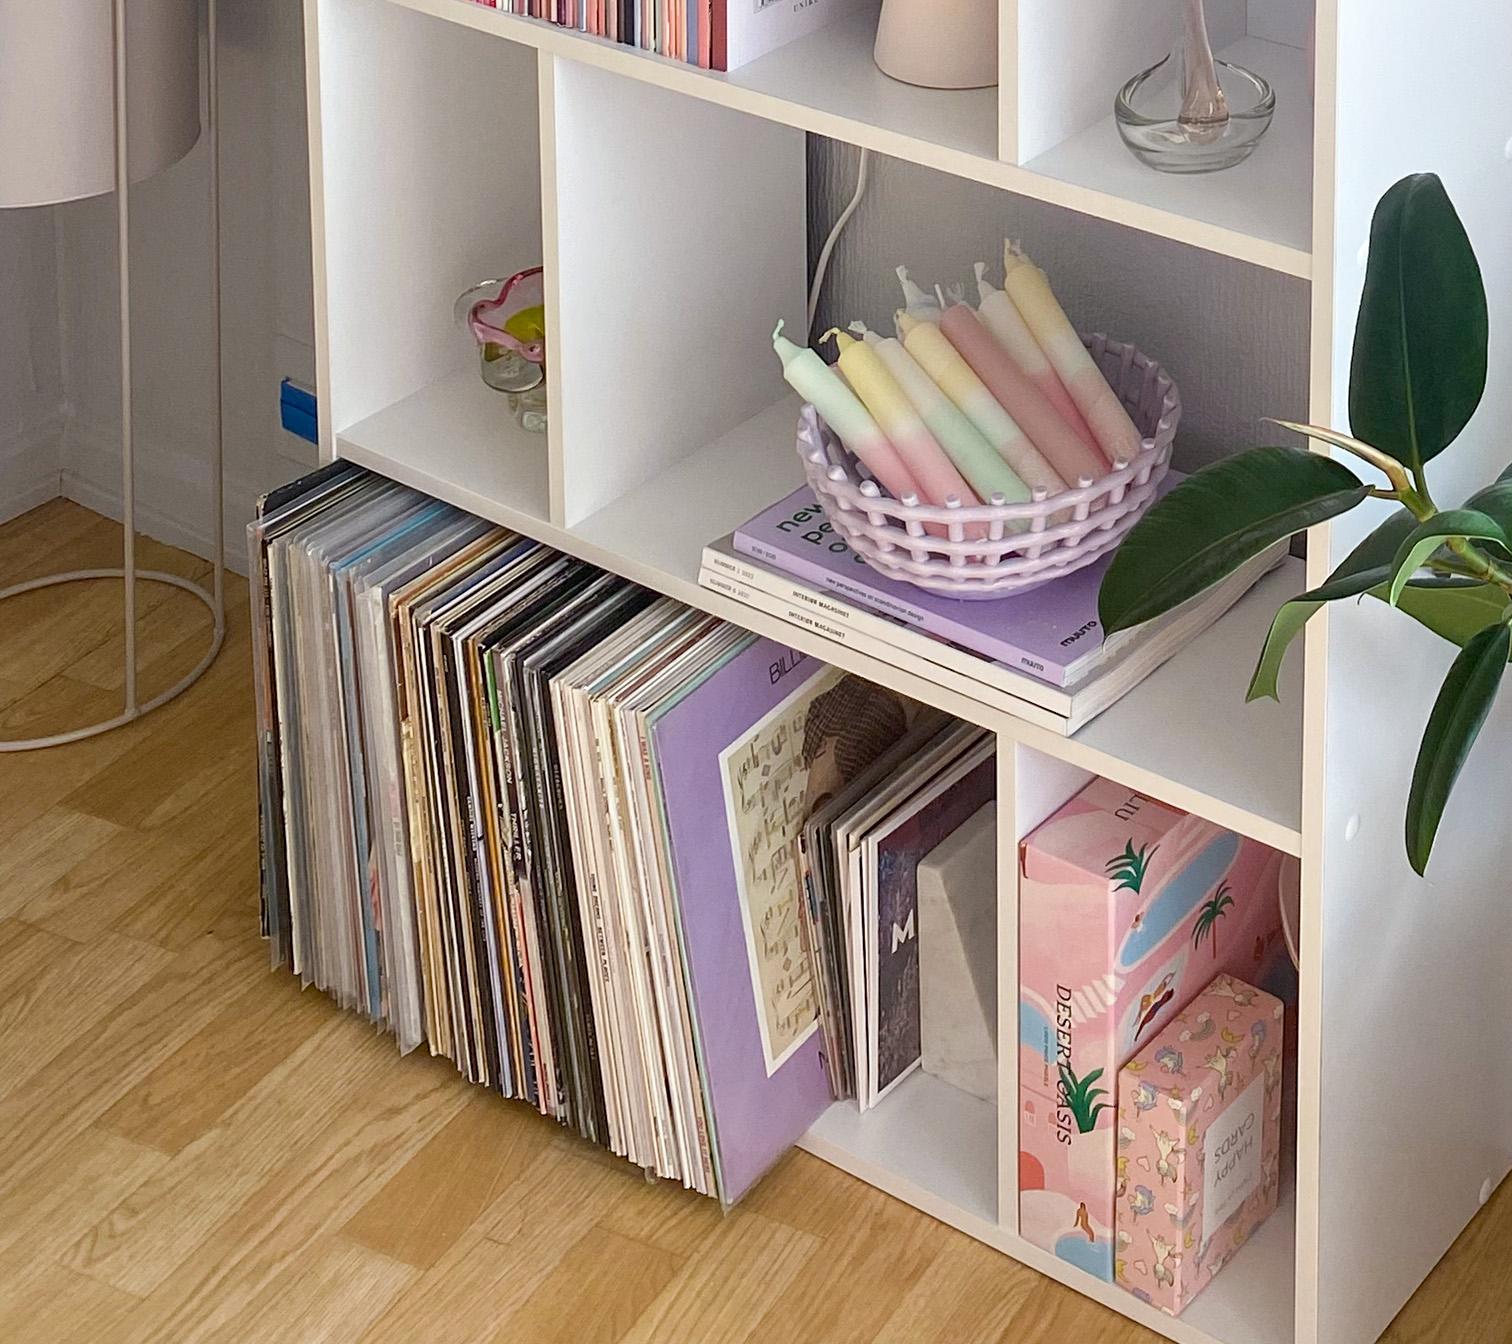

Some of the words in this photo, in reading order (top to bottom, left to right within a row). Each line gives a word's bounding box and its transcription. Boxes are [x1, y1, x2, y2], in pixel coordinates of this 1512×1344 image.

[814, 621, 846, 640] MAGASINET
[818, 600, 850, 619] MAGASINET
[825, 576, 836, 586] new
[1020, 656, 1045, 672] muuto
[1060, 619, 1098, 648] muuto
[502, 738, 513, 785] JACKSON
[510, 812, 523, 862] THRILLER
[597, 926, 607, 957] BETWEEN
[1056, 983, 1072, 1070] DESERT
[1213, 1135, 1254, 1188] HAPPY
[1214, 1112, 1256, 1165] CARDS
